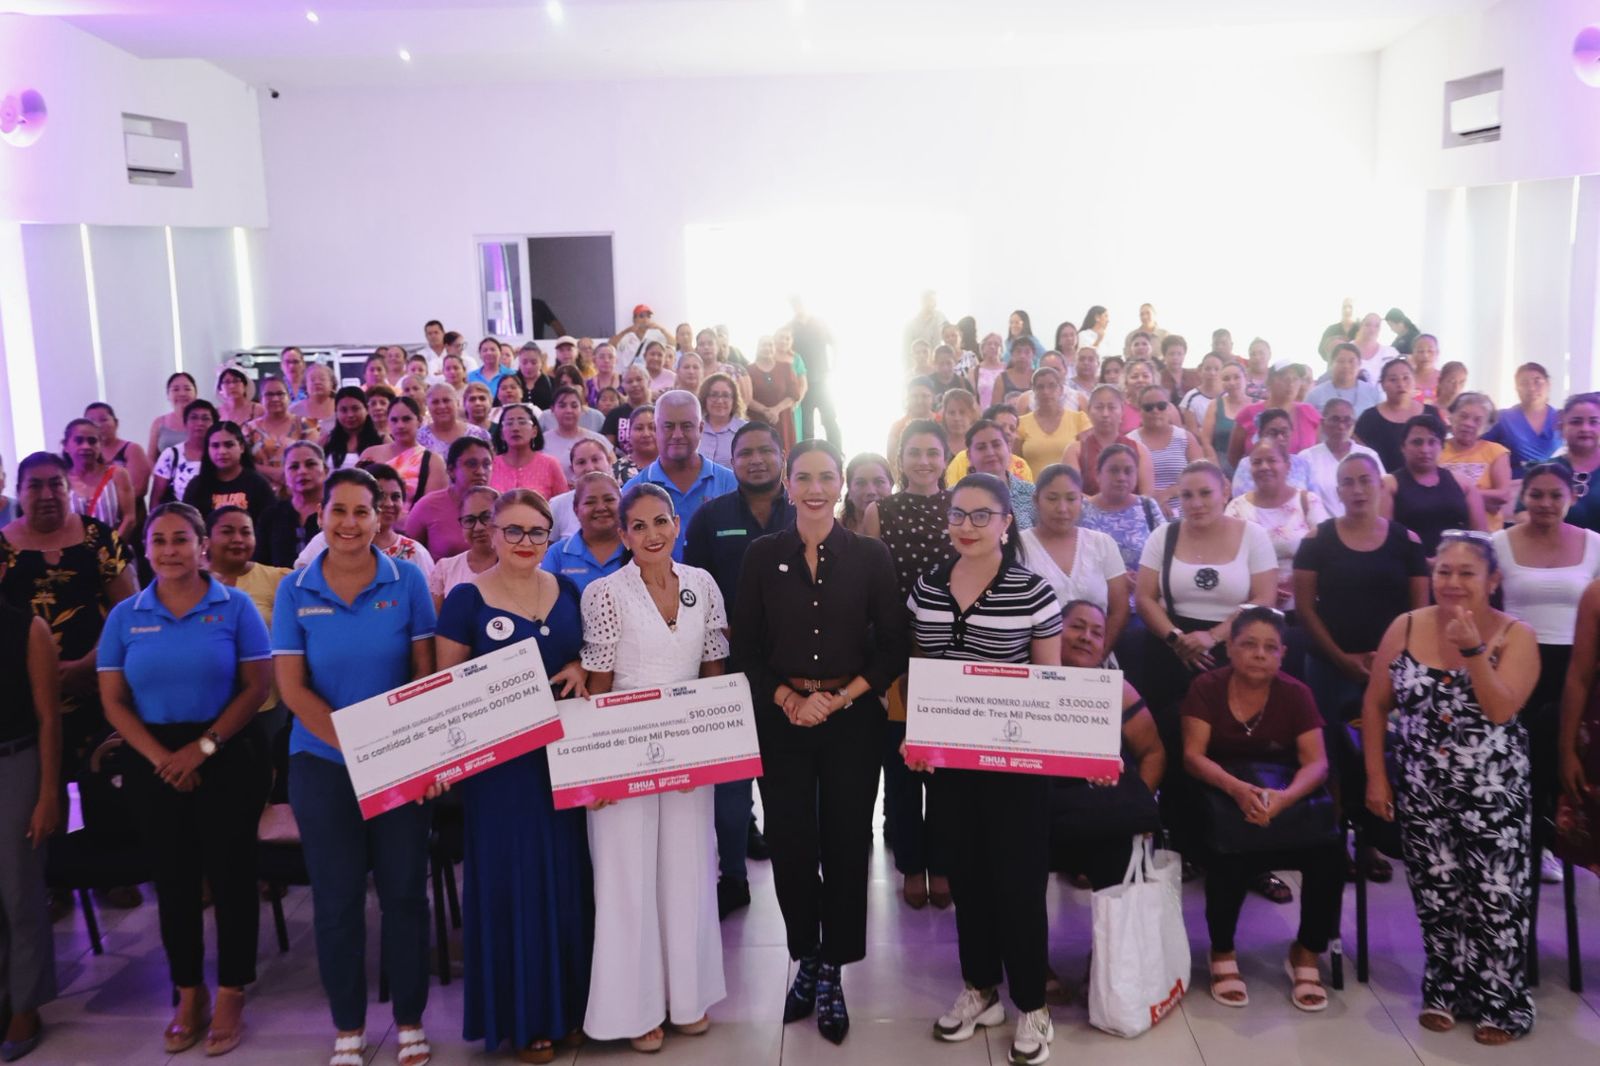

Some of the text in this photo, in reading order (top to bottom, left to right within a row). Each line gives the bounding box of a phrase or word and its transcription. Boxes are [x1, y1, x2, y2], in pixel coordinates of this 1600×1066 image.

[488, 670, 536, 694] $6,000.00
[1100, 675, 1111, 683] 01
[955, 695, 985, 705] IVONNE
[986, 697, 1020, 707] ROMERO
[1022, 698, 1050, 709] JUÁREZ
[1059, 697, 1110, 709] $3,000.00
[689, 703, 741, 720] $10,000.00
[917, 704, 929, 713] La
[930, 706, 970, 716] cantidad
[972, 707, 986, 717] de:
[988, 708, 1008, 719] Tres
[1009, 710, 1023, 720] Mil
[1025, 711, 1052, 722] Pesos
[1053, 713, 1089, 724] 00/100
[356, 754, 370, 764] La
[371, 735, 411, 758] cantidad
[427, 722, 447, 735] Seis
[448, 715, 461, 727] Mil
[462, 705, 489, 721] Pesos
[489, 691, 522, 710] 00/100
[557, 747, 570, 756] La
[571, 738, 611, 753] cantidad
[628, 734, 648, 745] Diez
[649, 730, 662, 740] Mil
[664, 728, 690, 739] Pesos
[691, 721, 726, 735] 00/100
[979, 754, 1007, 765] ZIHUA
[434, 765, 462, 780] ZIHUA
[628, 779, 656, 791] ZIHUA
